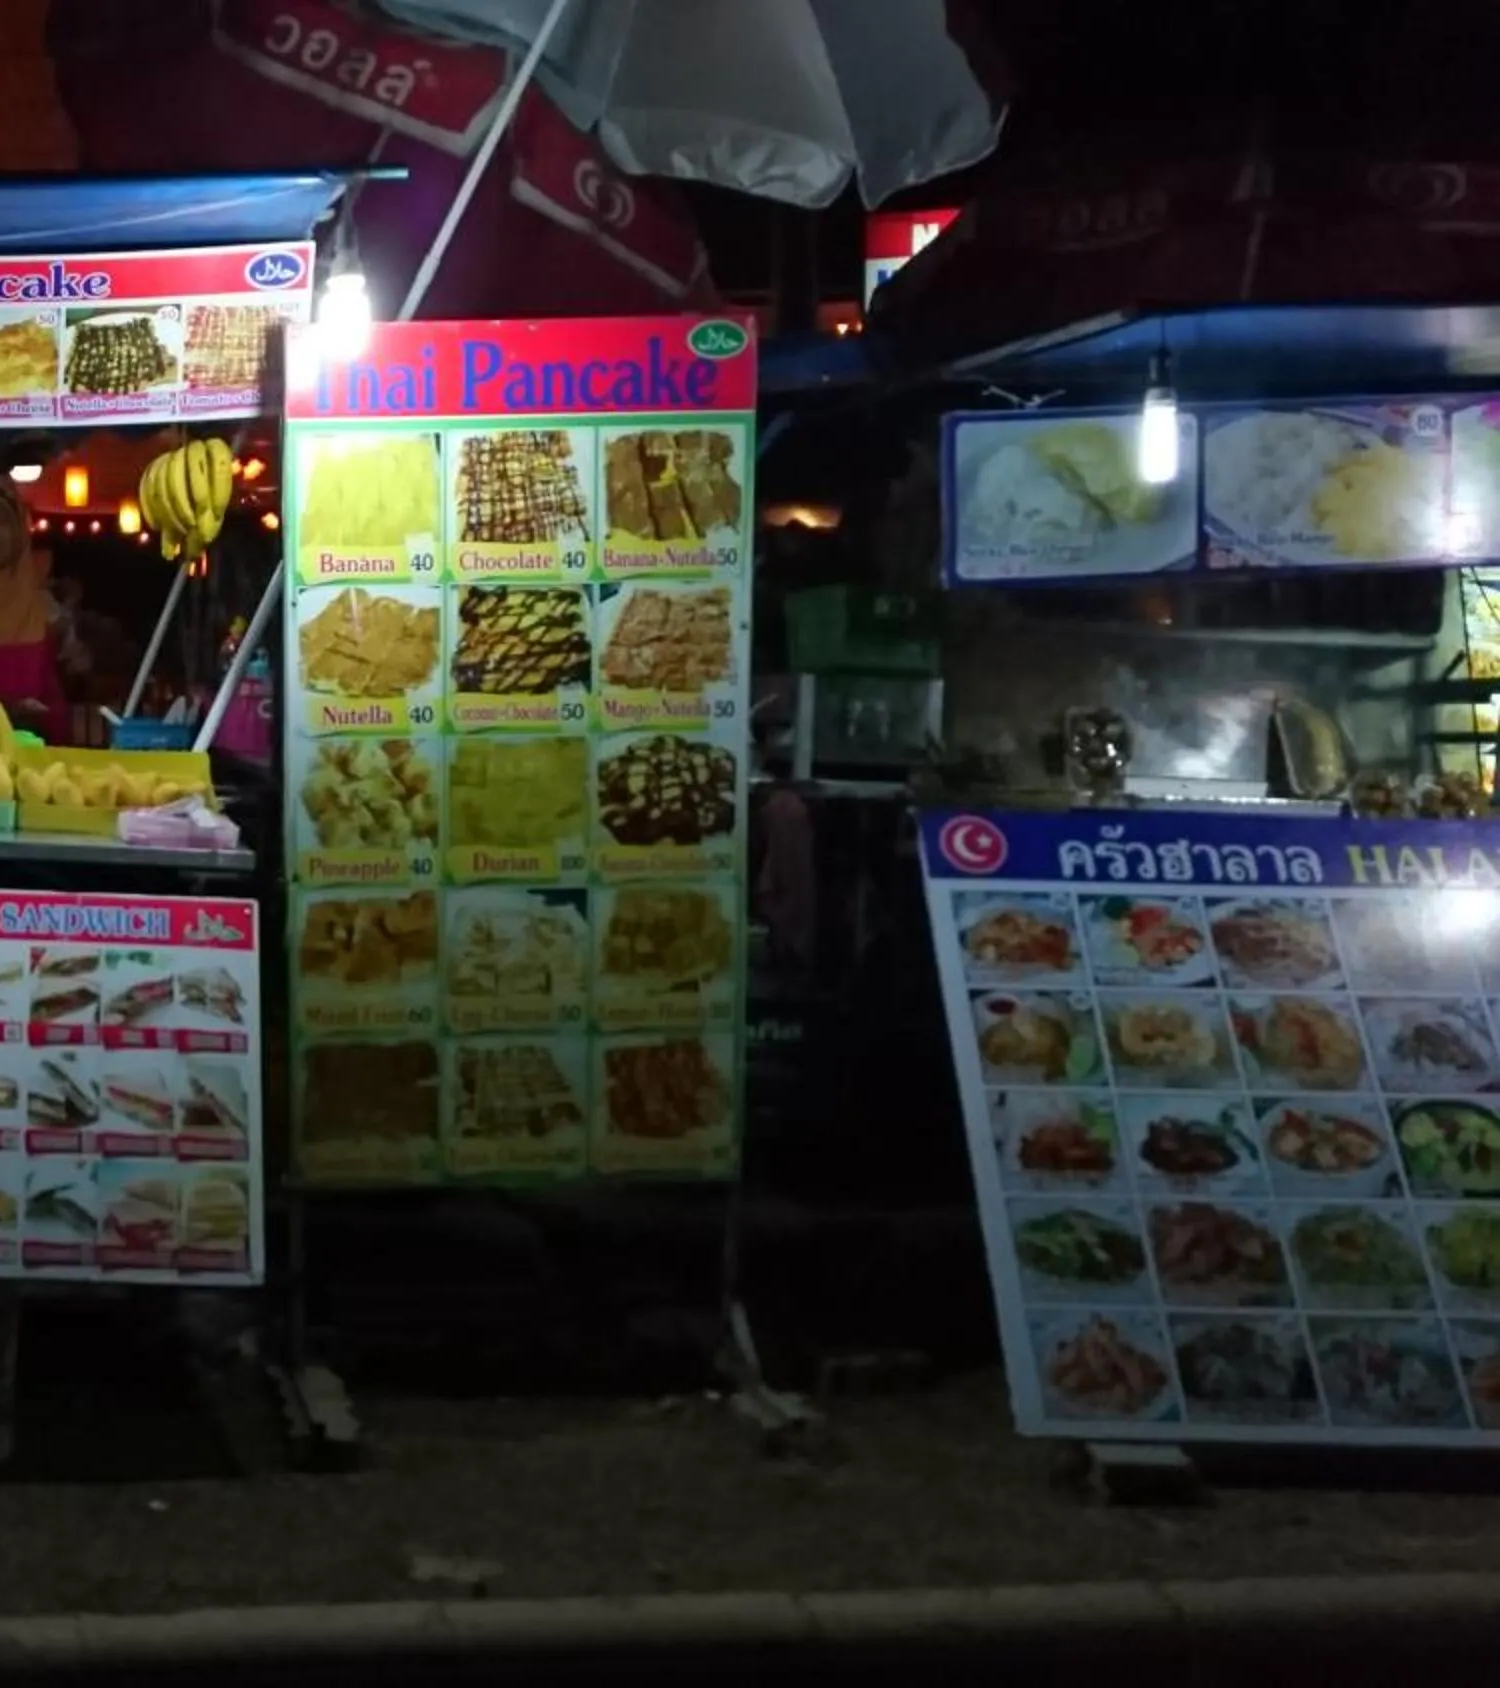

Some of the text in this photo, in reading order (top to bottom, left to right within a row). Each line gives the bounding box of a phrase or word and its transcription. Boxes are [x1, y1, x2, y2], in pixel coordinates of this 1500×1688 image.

[461, 337, 718, 411] Pancake
[319, 552, 434, 572] Banana 40
[459, 551, 586, 572] Chocolate 40
[716, 549, 737, 566] 50
[322, 705, 434, 725] Nutella 40
[560, 704, 584, 721] 50
[713, 701, 735, 718] 50
[471, 853, 540, 873] Durian
[1058, 824, 1323, 884] ครัวฮาลาล
[309, 857, 433, 882] Pineapple 40
